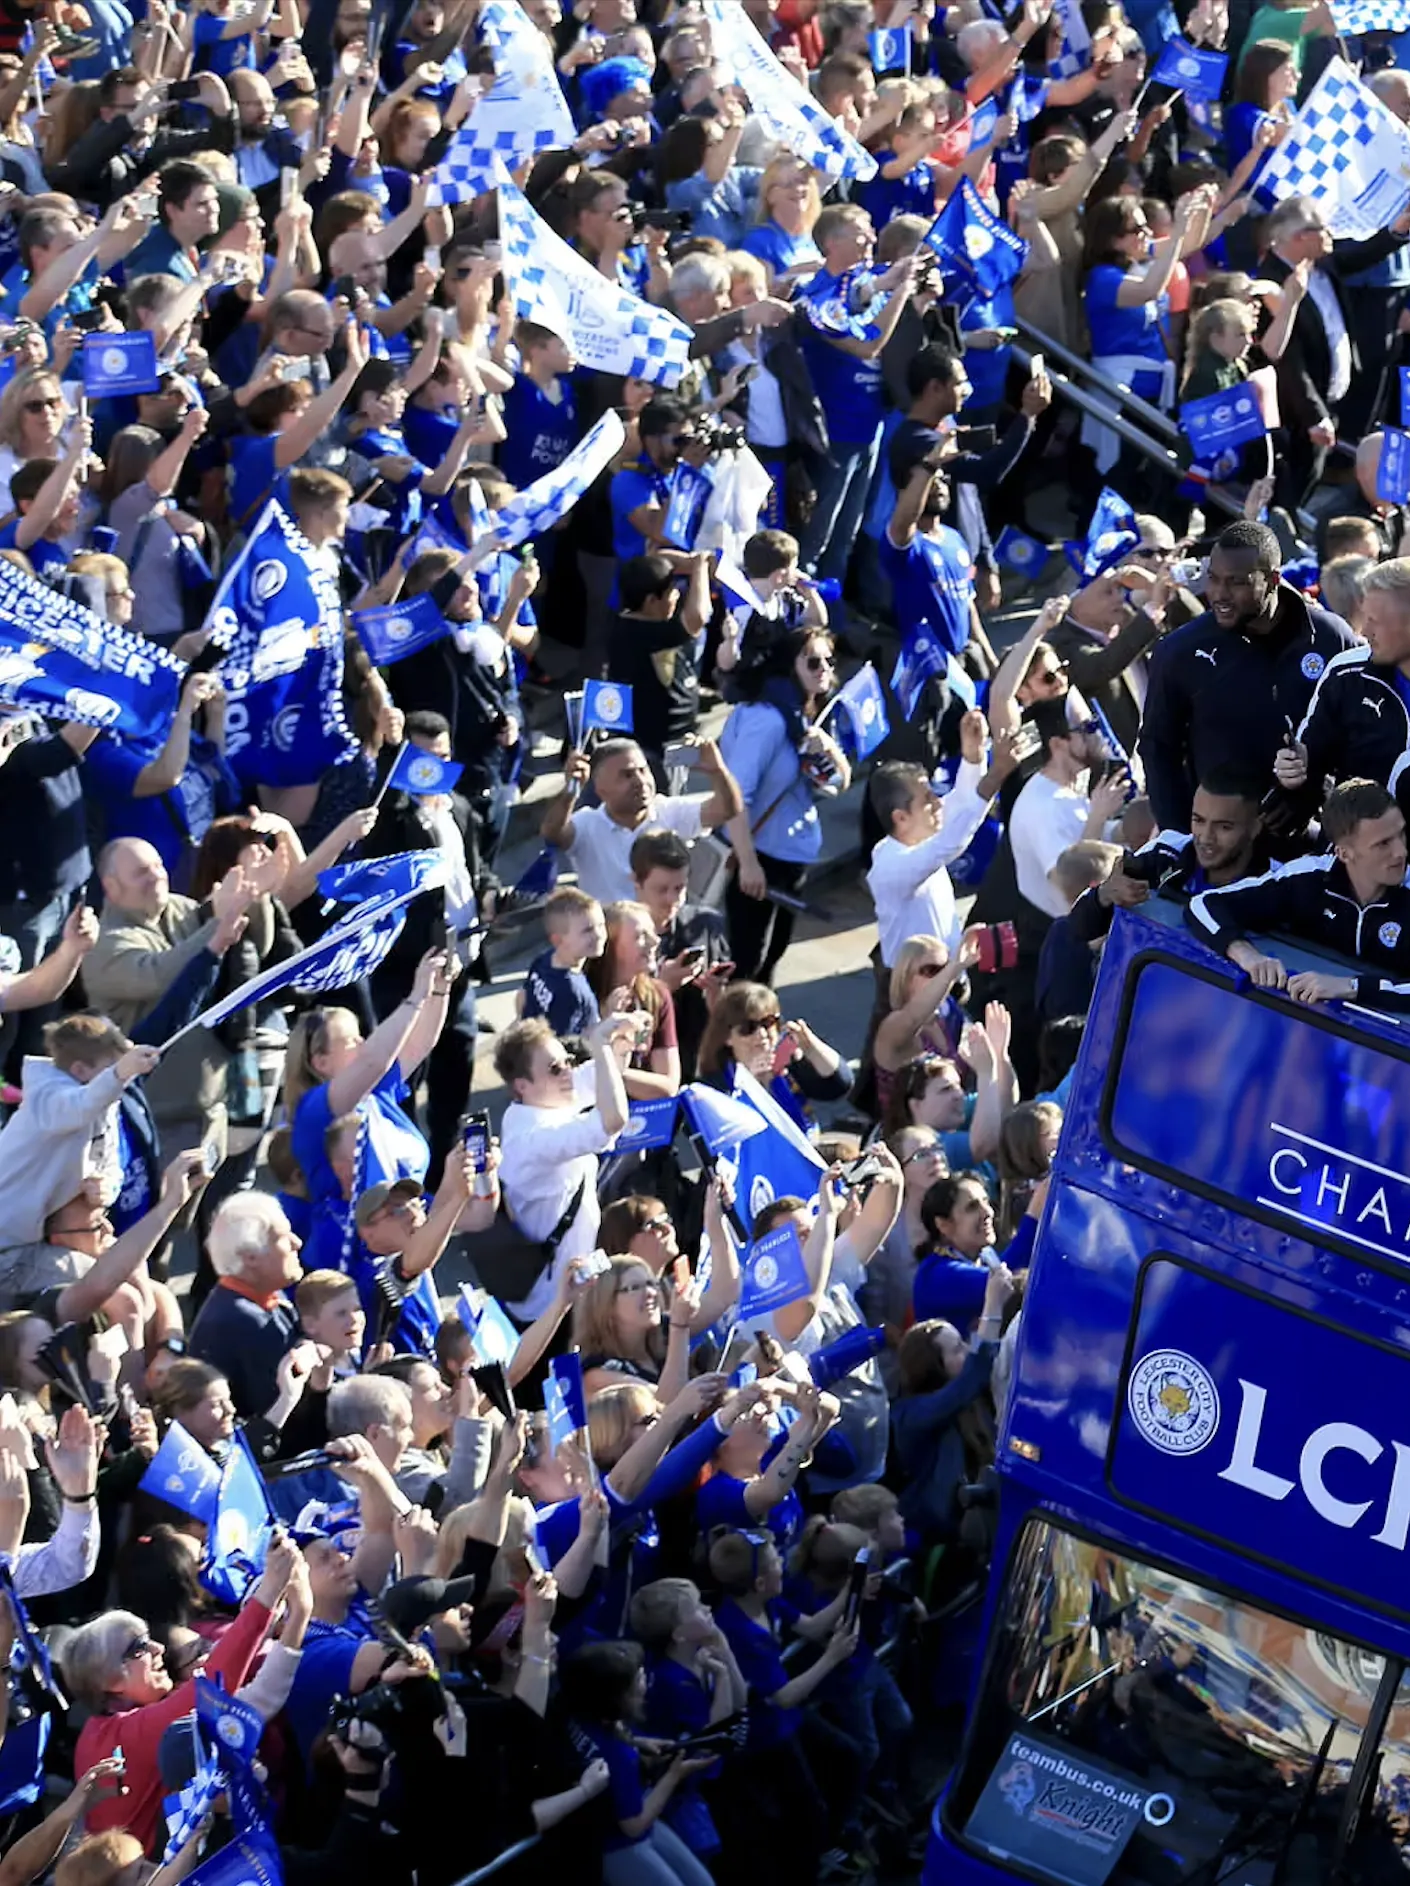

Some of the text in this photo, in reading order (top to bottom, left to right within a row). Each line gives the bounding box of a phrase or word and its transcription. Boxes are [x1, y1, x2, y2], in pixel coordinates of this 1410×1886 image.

[1140, 1358, 1213, 1414] LEICESTER CITY
[1136, 1392, 1210, 1446] FOOTBALL CLUB
[1010, 1740, 1142, 1810] teambus.co.uk
[1037, 1780, 1128, 1838] Knight
